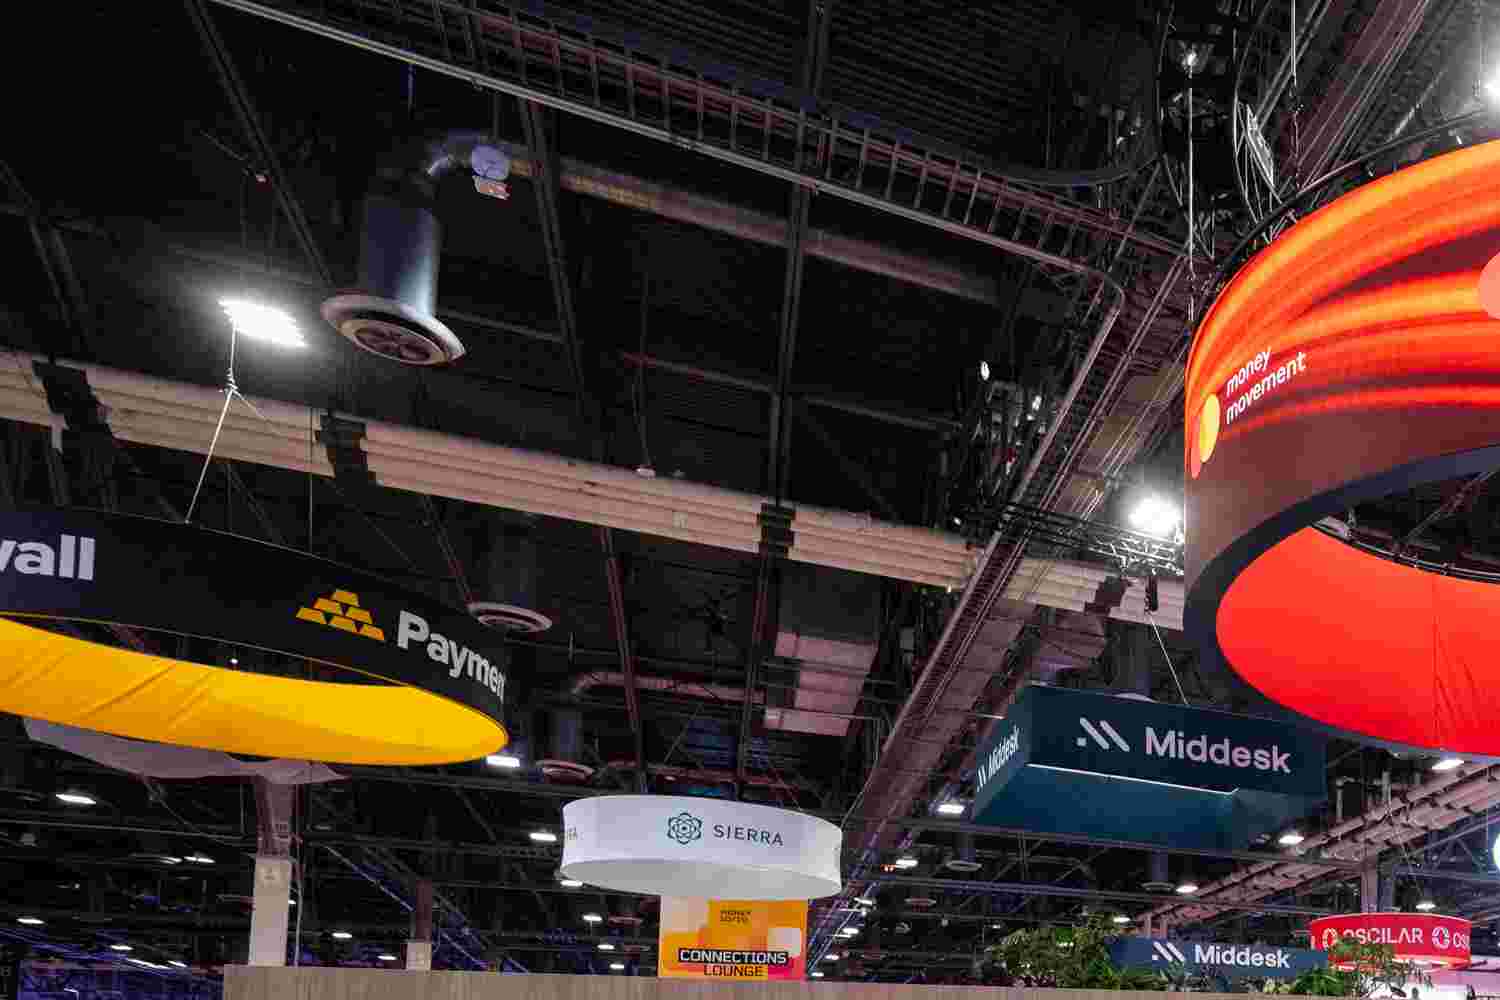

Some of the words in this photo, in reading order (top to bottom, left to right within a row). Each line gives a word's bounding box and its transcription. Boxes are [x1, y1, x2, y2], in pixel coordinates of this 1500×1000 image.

[1226, 345, 1272, 397] money
[1226, 351, 1307, 425] movement
[0, 534, 96, 581] all
[1145, 726, 1291, 774] Middesk
[713, 824, 784, 846] SIERRA
[679, 949, 788, 965] CONNECTIONS
[703, 964, 764, 977] LOUNGE
[1194, 944, 1290, 969] Middesk
